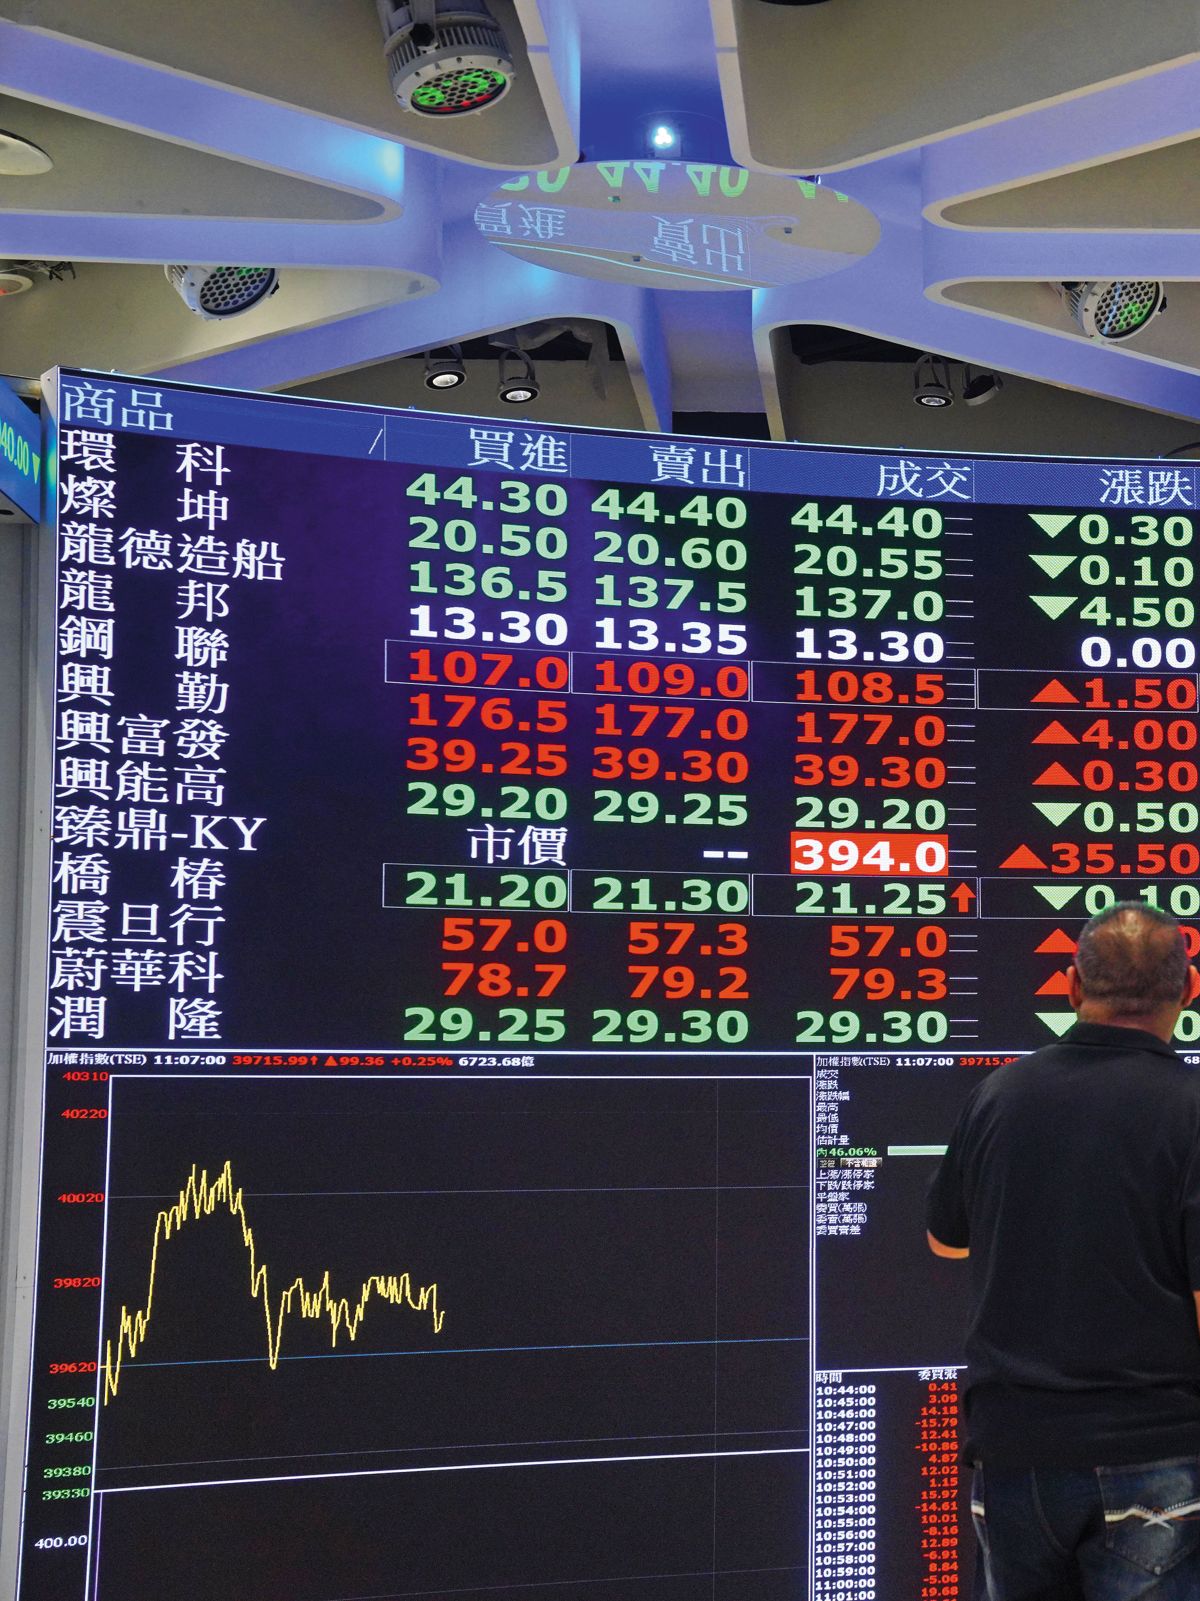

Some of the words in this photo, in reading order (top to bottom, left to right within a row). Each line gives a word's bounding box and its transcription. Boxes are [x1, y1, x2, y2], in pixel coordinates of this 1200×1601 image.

[61, 381, 174, 432] 商品
[468, 427, 568, 474] 買進
[650, 447, 747, 489] 賣出
[876, 461, 972, 499] 成交
[1100, 470, 1193, 508] 漲跌
[60, 430, 117, 475] 環
[176, 443, 231, 487] 科
[406, 474, 569, 518] 44.30
[591, 489, 748, 530] 44.40
[791, 503, 944, 540] 44.40
[1079, 514, 1195, 548] 0.30
[408, 517, 569, 561] 20.50
[593, 531, 748, 572] 20.60
[793, 544, 944, 582] 20.55
[1079, 555, 1195, 589] 0.10
[60, 520, 286, 582] 龍德造船
[410, 562, 568, 604] 136.5
[595, 575, 748, 614] 137.5
[796, 587, 945, 623] 137.0
[1079, 596, 1196, 629] 4.50
[409, 605, 570, 647] 13.30
[595, 618, 749, 657] 13.35
[795, 628, 946, 665] 13.30
[59, 615, 114, 660] 鋼
[175, 626, 229, 669] 聯
[410, 650, 570, 691] 107.0
[595, 661, 749, 699] 109.0
[796, 671, 945, 706] 108.5
[410, 694, 569, 734] 176.5
[595, 704, 750, 742] 177.0
[55, 710, 230, 762] 興富發
[406, 738, 569, 778] 39.25
[592, 747, 750, 785] 39.30
[55, 756, 226, 807] 興能高
[406, 782, 569, 822] 29.20
[1082, 802, 1200, 834] 0.50
[54, 804, 267, 853] 臻鼎-KY
[467, 824, 568, 866] 市價
[793, 839, 948, 873] 394.0
[1051, 843, 1200, 875] 35.50
[405, 872, 568, 910] 21.20
[795, 882, 947, 916] 21.25
[53, 901, 226, 947] 震旦行
[442, 918, 568, 954] 57.0
[628, 922, 749, 957] 57.3
[50, 949, 225, 995] 蔚華科
[442, 963, 568, 998] 78.7
[830, 968, 948, 1002] 79.3
[403, 1007, 567, 1044] 29.25
[153, 1055, 226, 1066] 11:07:00
[232, 1055, 307, 1066] 39715.99
[339, 1056, 385, 1066] 99.36
[391, 1056, 453, 1066] +0.25%
[896, 1058, 954, 1066] 11:07:00
[62, 1071, 109, 1081] 40310
[829, 1147, 877, 1157] 46.06%
[57, 1192, 105, 1203] 40020
[53, 1277, 101, 1289] 39820
[49, 1361, 97, 1374] 39620
[815, 1372, 843, 1384] 時間
[816, 1385, 876, 1396] 10:44:00
[928, 1382, 958, 1392] 0.41
[47, 1397, 95, 1409] 39540
[816, 1397, 876, 1408] 10:45:00
[816, 1421, 876, 1432] 10:47:00
[43, 1466, 91, 1479] 39380
[815, 1493, 876, 1504] 10:53:00
[34, 1534, 88, 1549] 400.00
[815, 1566, 876, 1578] 10:59:00
